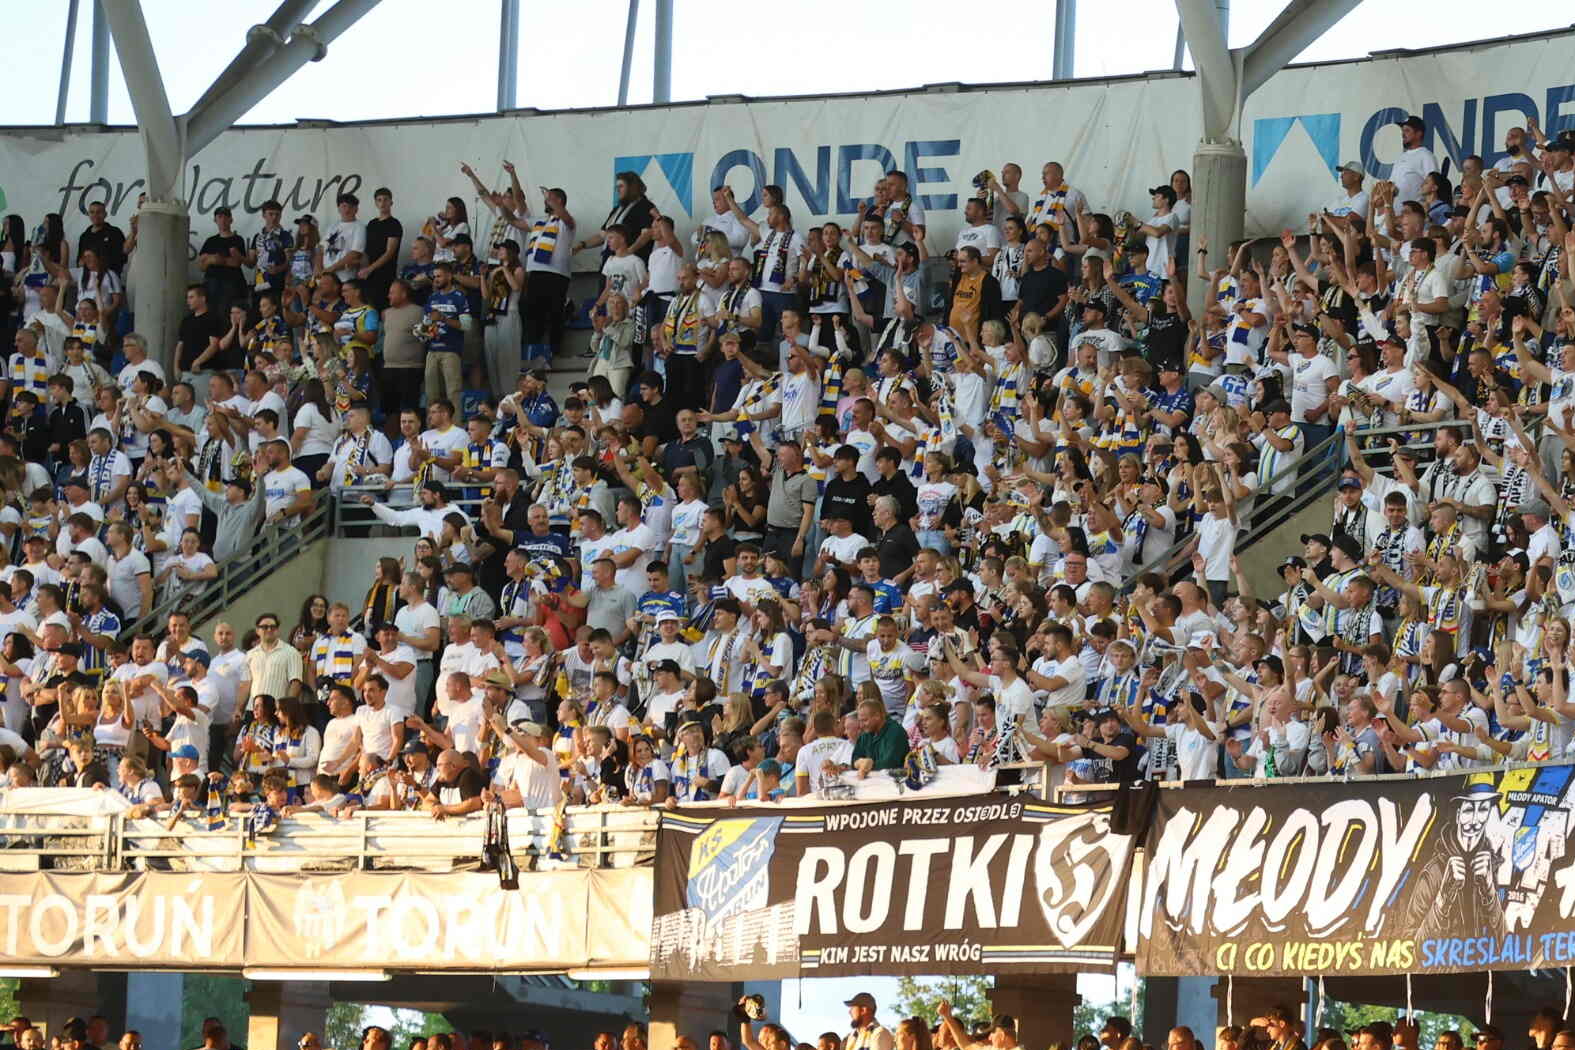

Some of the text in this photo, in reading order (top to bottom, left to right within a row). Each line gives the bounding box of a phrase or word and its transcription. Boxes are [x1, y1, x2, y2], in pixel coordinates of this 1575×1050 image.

[186, 157, 363, 216] ature
[710, 138, 960, 220] ONDE
[825, 809, 898, 832] WPOJONE
[902, 807, 949, 826] PRZEZ
[796, 831, 1034, 936] ROTKI
[1140, 792, 1434, 940] MŁODY
[3, 876, 215, 958] TORUŃ
[346, 876, 560, 959] TORUŃ
[820, 943, 982, 964] KIM JEST NASZ WRÓG
[1215, 942, 1236, 971] CI
[1245, 942, 1276, 971] CO
[1283, 931, 1364, 971] KIEDYŚ
[1369, 938, 1416, 970] NAS
